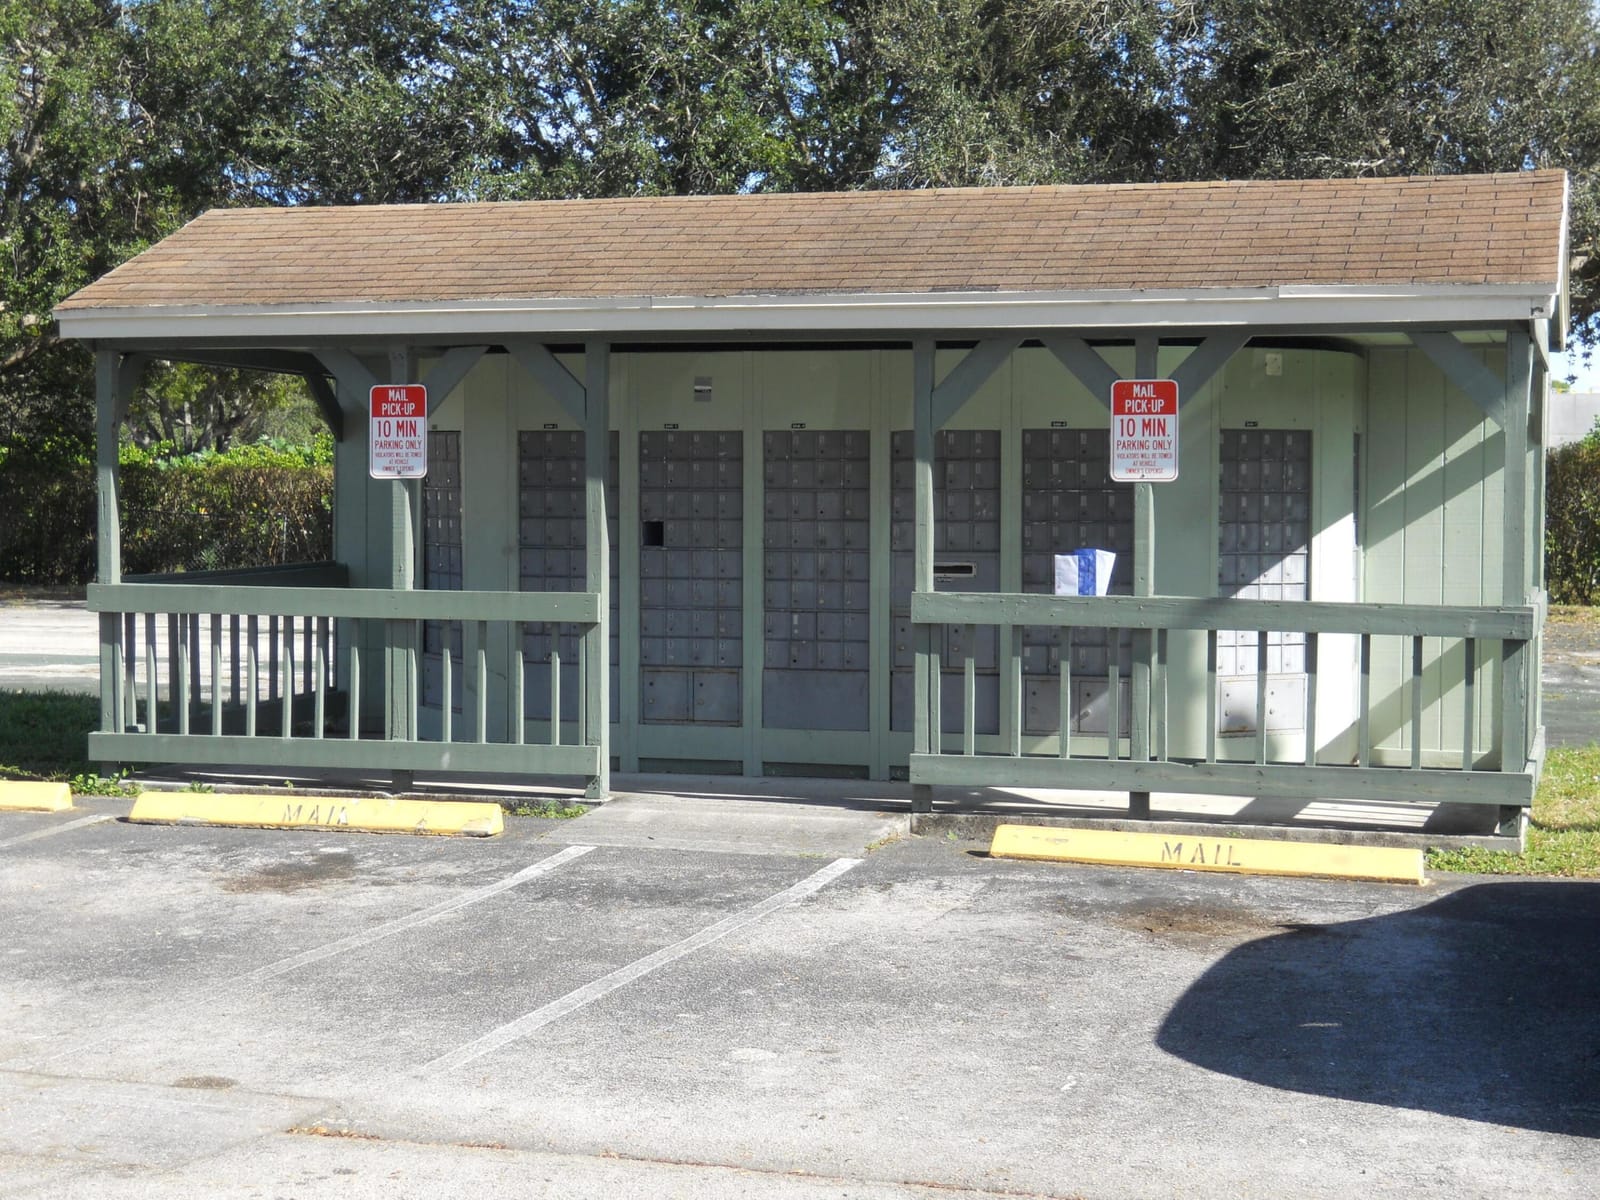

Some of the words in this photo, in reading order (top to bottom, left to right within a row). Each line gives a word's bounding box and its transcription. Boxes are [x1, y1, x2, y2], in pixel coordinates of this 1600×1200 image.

[388, 389, 409, 402] MAIL
[1133, 384, 1157, 398] MAIL
[381, 402, 416, 416] PICK-UP
[1124, 399, 1165, 413] PICK-UP
[377, 420, 391, 438] 10
[396, 420, 420, 438] MIN.
[1120, 418, 1136, 437] 10
[1142, 418, 1170, 437] MIN.
[374, 440, 404, 450] PARKING
[405, 440, 423, 450] ONLY
[1116, 440, 1150, 450] PARKING
[1152, 440, 1173, 450] ONLY
[1161, 841, 1241, 866] MAIL
